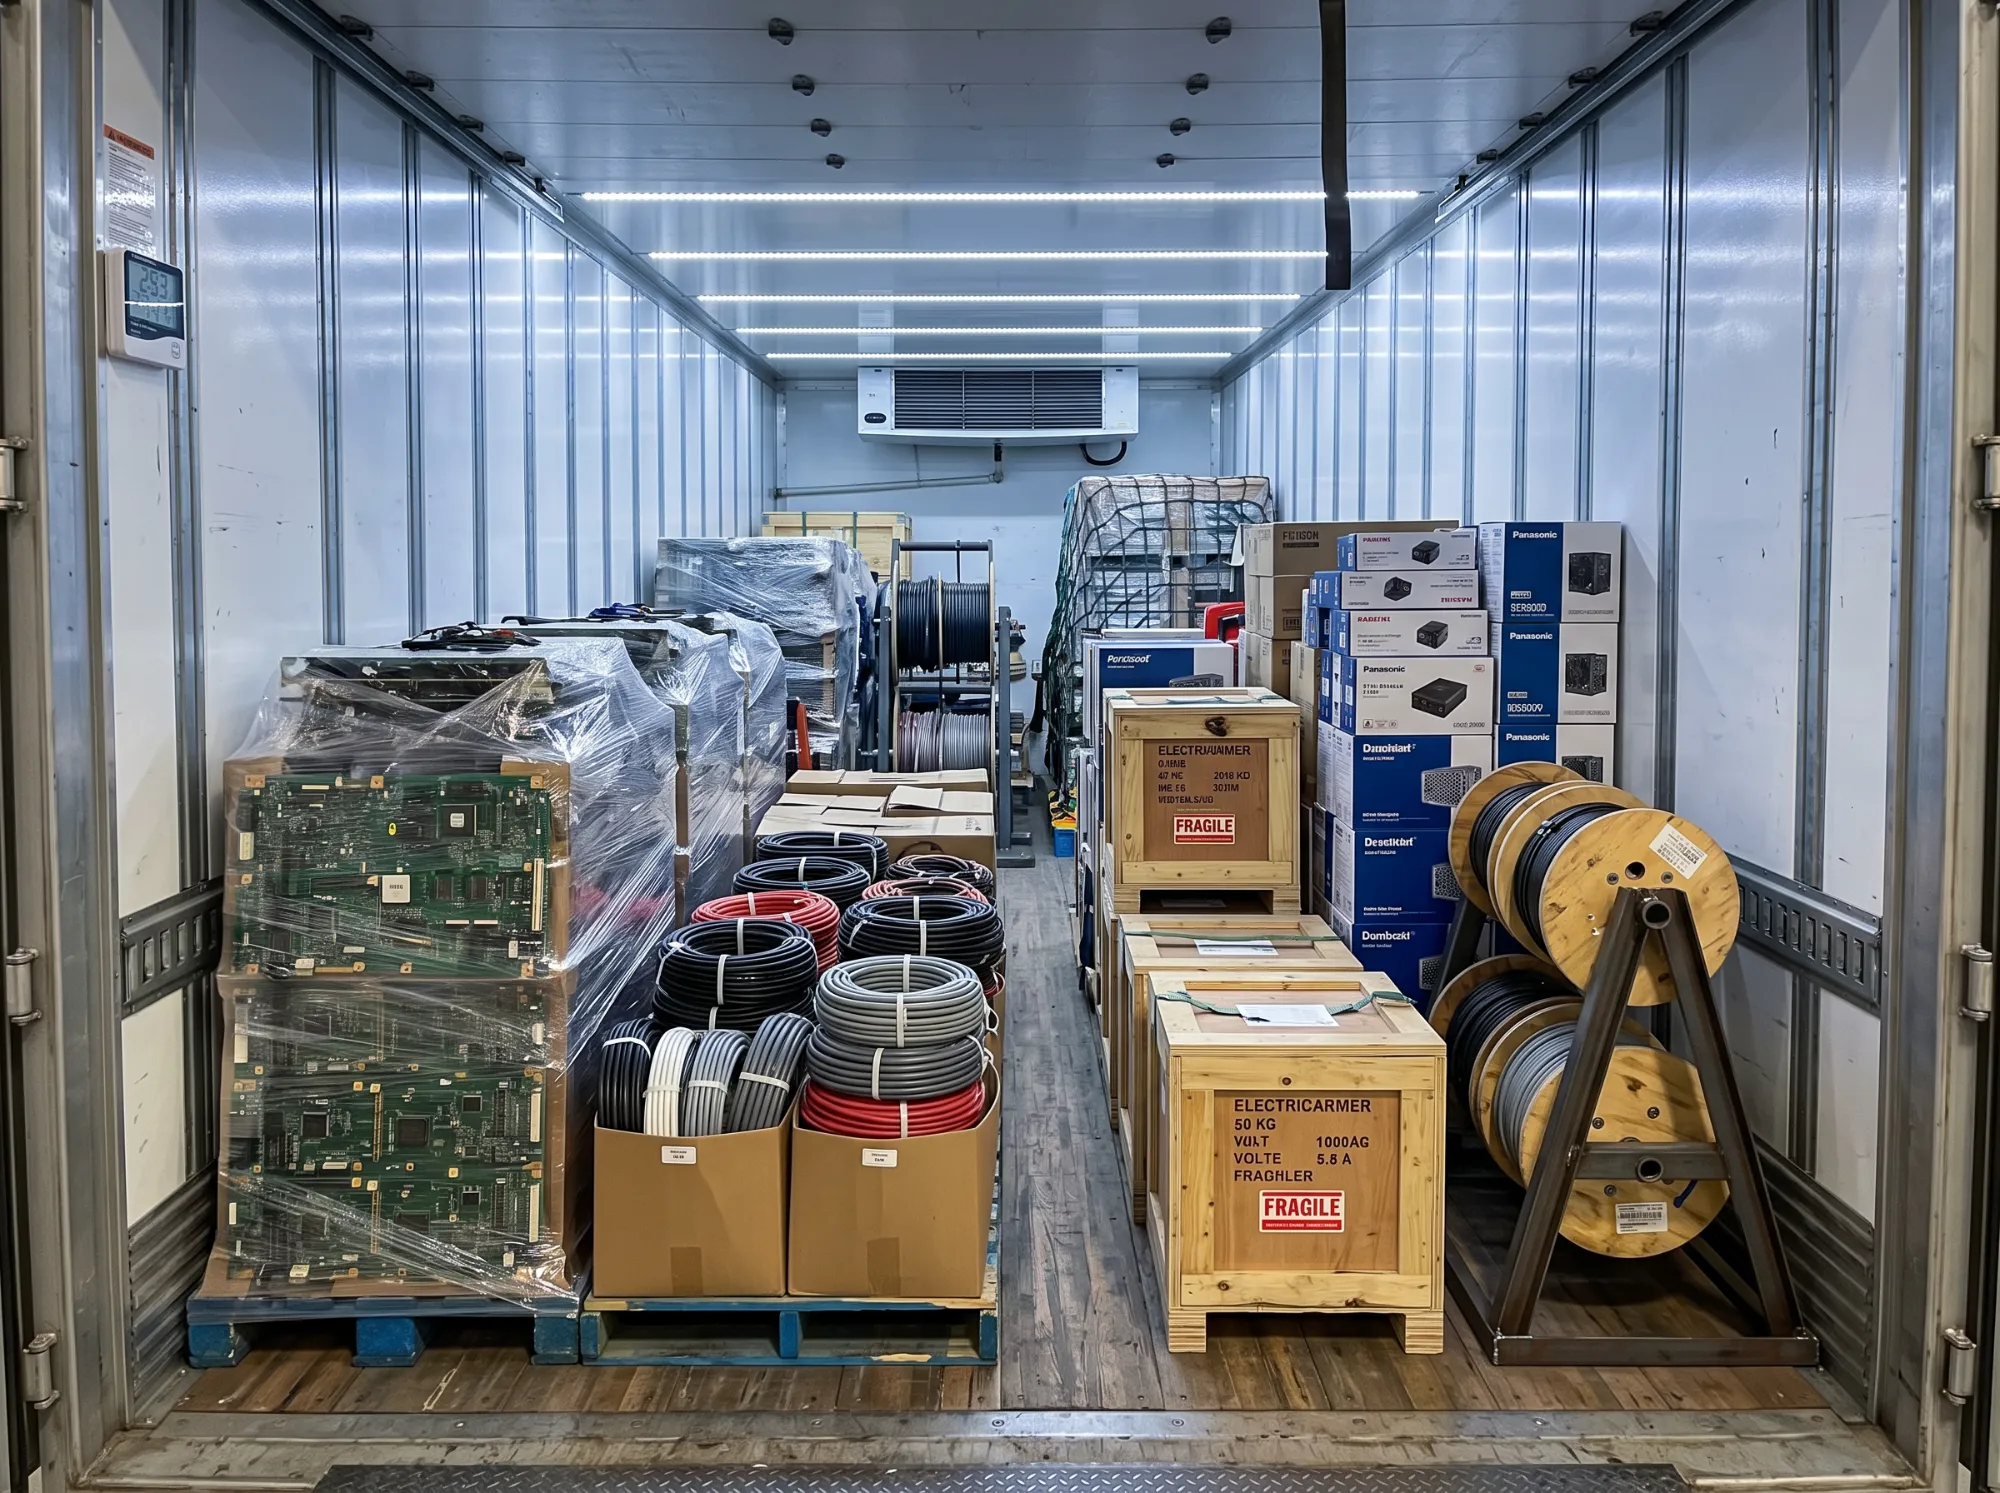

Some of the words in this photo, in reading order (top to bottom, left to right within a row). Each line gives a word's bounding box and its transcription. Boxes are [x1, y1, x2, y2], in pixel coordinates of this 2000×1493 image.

[1512, 531, 1558, 539] Panasonic
[1363, 665, 1406, 673] Panasonic
[1505, 733, 1550, 741] Panasonic
[1236, 771, 1251, 780] KD
[1176, 819, 1233, 833] FRAGILE
[1234, 1099, 1372, 1113] ELECTRICARMER
[1234, 1118, 1251, 1130] 50
[1256, 1118, 1276, 1130] KG
[1316, 1136, 1369, 1148] 1000AG
[1234, 1152, 1281, 1165] VOLTE
[1342, 1153, 1352, 1165] A
[1264, 1198, 1341, 1216] FRAGILE
